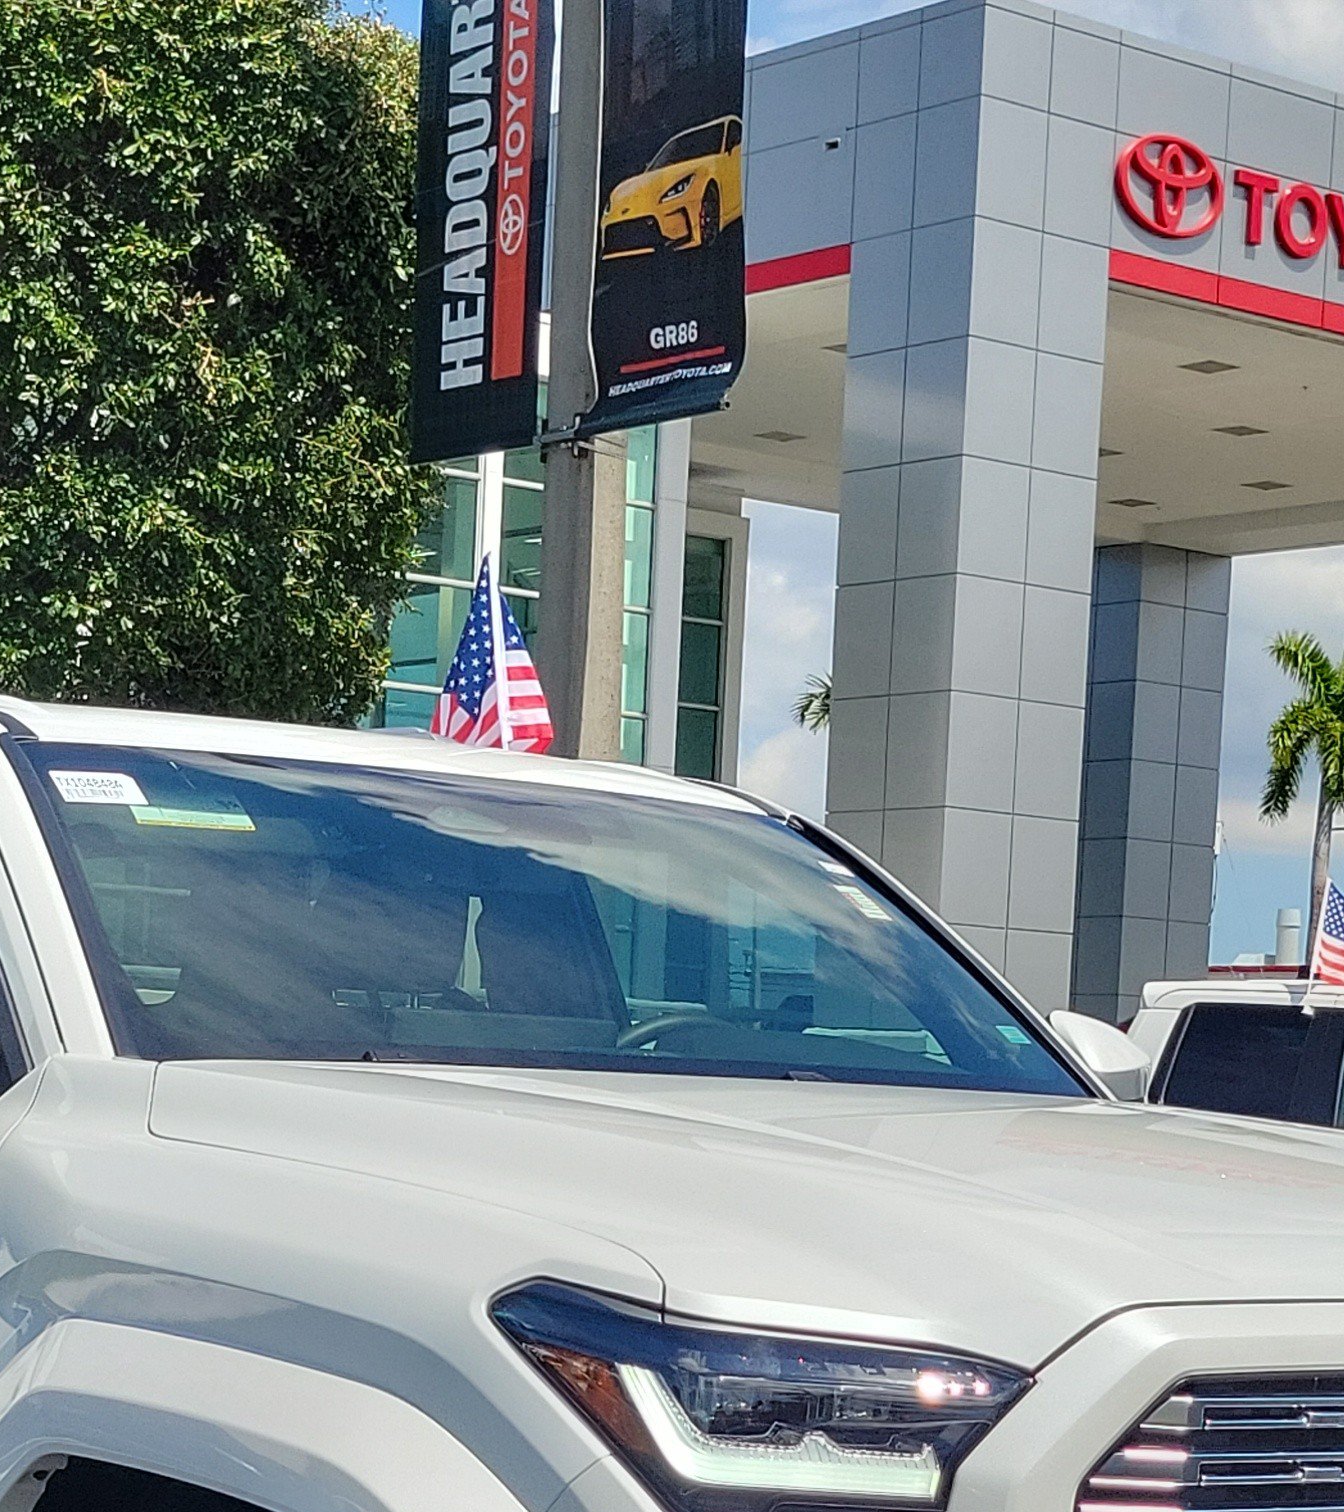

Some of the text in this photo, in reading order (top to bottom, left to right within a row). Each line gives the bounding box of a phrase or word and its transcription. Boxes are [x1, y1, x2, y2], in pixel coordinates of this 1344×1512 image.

[503, 0, 531, 188] TOYOTA
[440, 0, 495, 390] HEADQUAR
[649, 320, 698, 350] GR86
